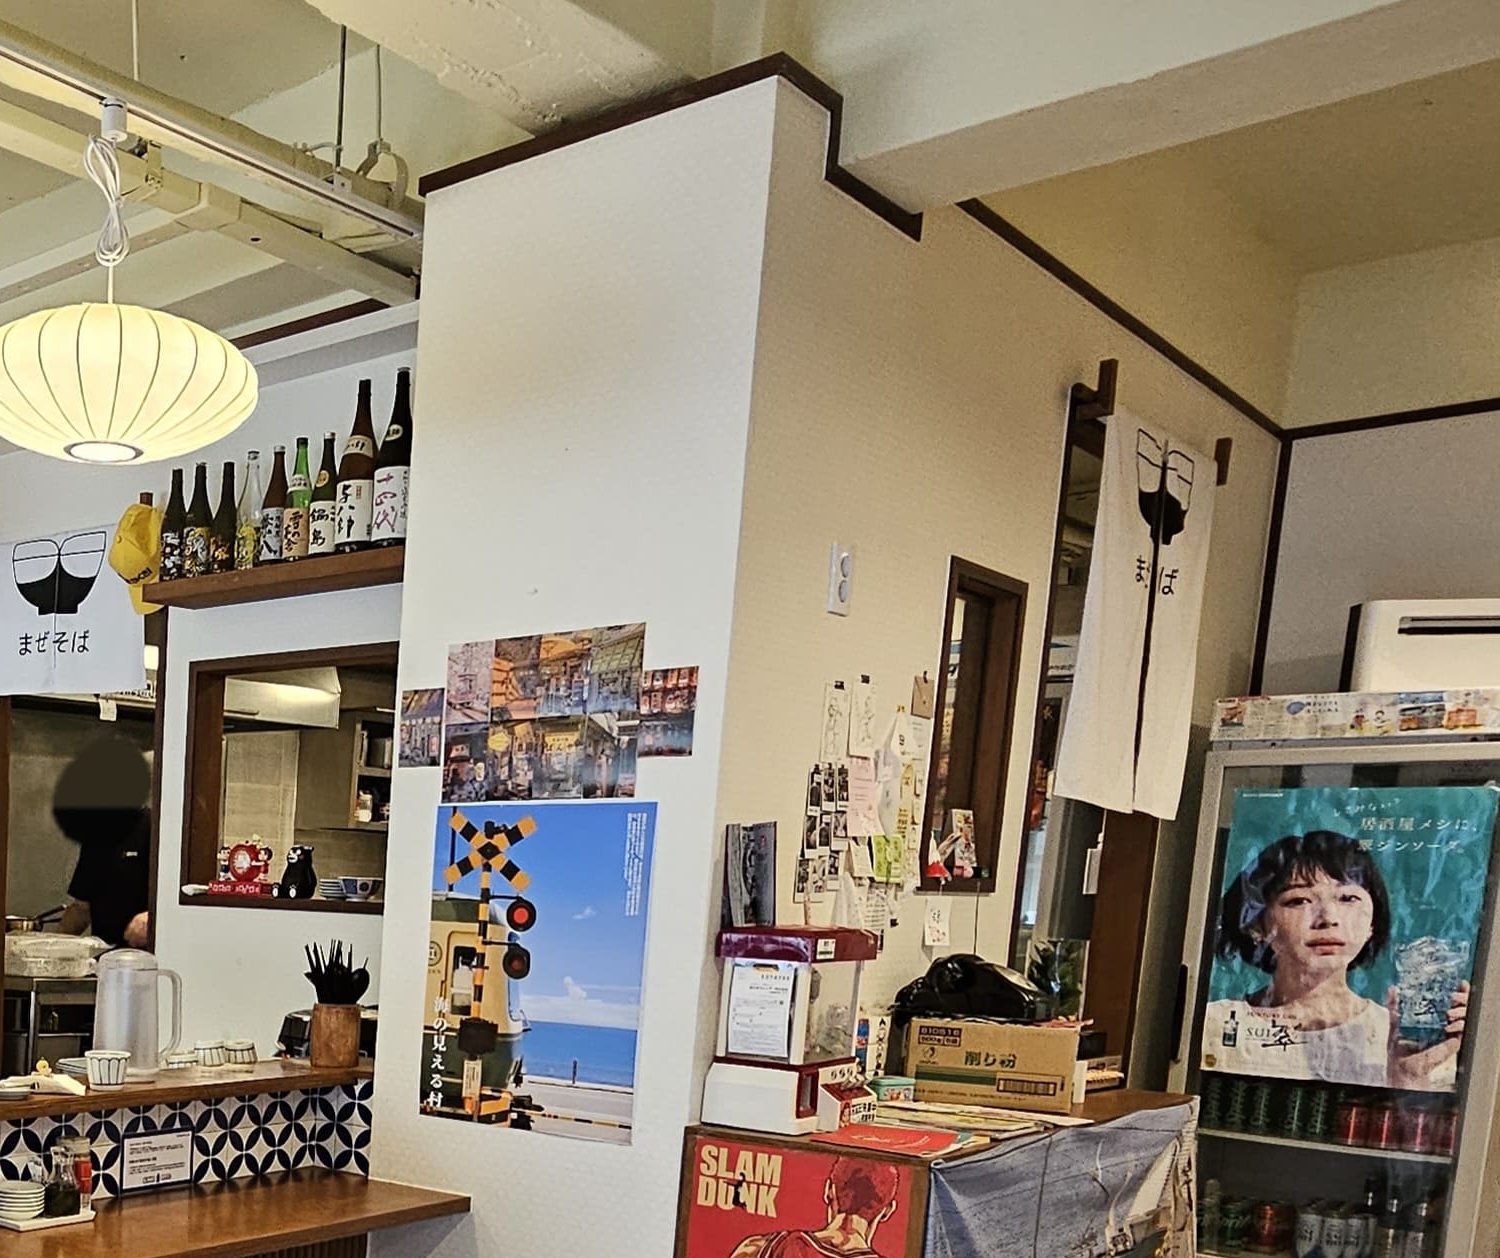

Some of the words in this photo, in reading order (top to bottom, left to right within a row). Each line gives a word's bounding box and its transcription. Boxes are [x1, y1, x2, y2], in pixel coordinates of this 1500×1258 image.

[18, 629, 90, 656] まぜそば
[964, 1050, 1018, 1069] 削り粉
[700, 1144, 783, 1187] SLAM
[697, 1174, 780, 1219] DUNK
